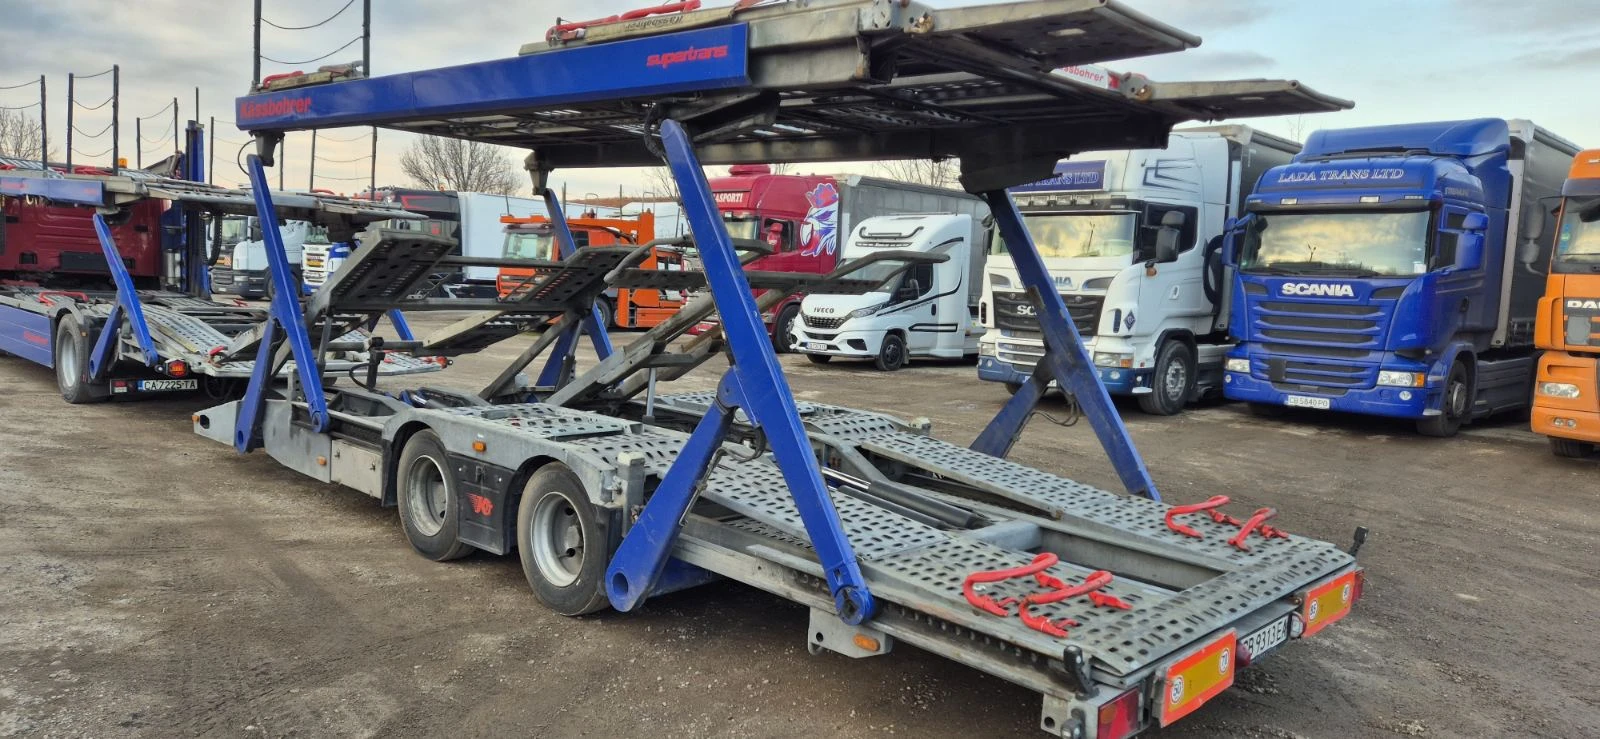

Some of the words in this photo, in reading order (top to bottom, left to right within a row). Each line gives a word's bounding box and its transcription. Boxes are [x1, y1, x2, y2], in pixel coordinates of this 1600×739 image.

[646, 45, 728, 69] supertrans
[1063, 66, 1104, 81] ssbohrer
[1074, 171, 1099, 185] LTD
[1278, 172, 1316, 183] LADA
[1320, 169, 1370, 181] TRANS
[1372, 167, 1404, 180] LTD
[712, 192, 743, 203] ASPORTI
[1282, 282, 1354, 297] SCANIA
[1567, 300, 1600, 309] DA
